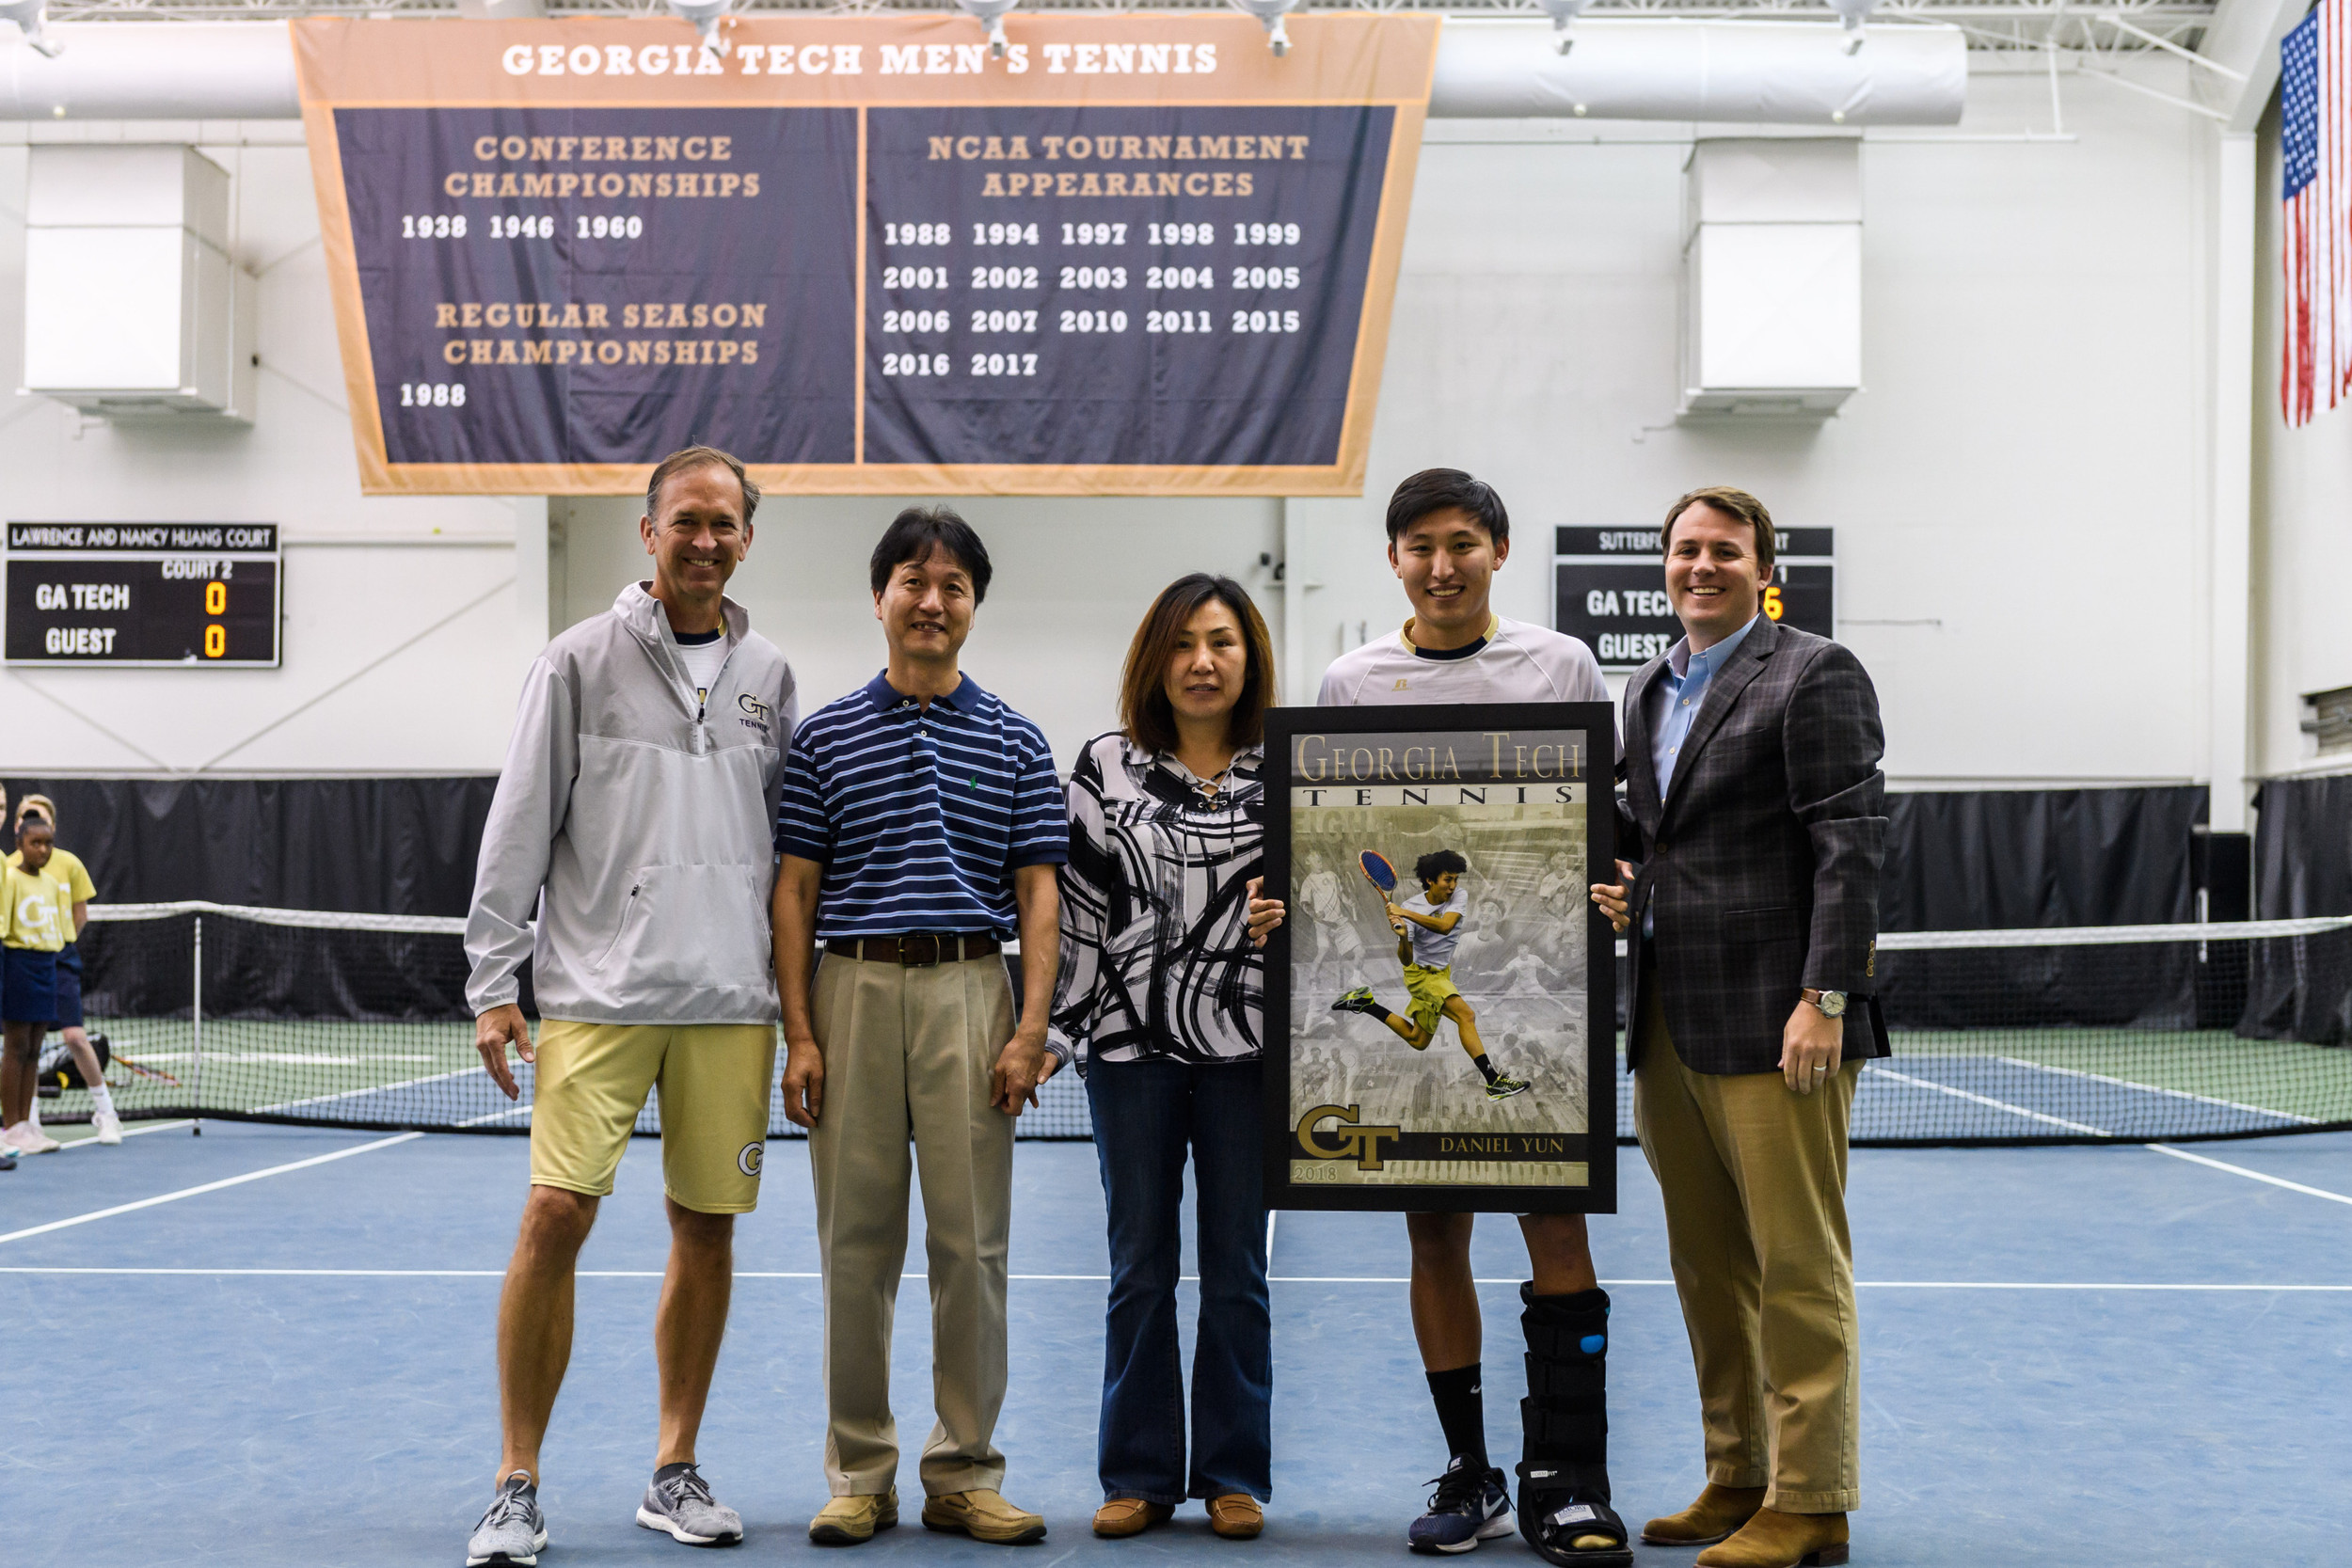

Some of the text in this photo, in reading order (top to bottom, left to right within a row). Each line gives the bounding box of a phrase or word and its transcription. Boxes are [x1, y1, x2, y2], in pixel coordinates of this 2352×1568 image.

[501, 43, 724, 76] GEORGIA
[736, 43, 864, 75] TECH
[1042, 43, 1218, 74] TENNIS
[473, 135, 733, 161] CONFERENCE
[928, 135, 1310, 161] NCAA TOURNAMENT
[443, 172, 761, 198] CHAMPIONSHIPS
[981, 172, 1254, 197] APPEARANCES
[401, 215, 643, 239] 1938 1946 1960
[884, 222, 1300, 246] 1988 1994 1997 1998 1999
[882, 266, 1300, 290] 2001 2002 2003 2004 2005
[435, 303, 768, 328] REGULAR SEASON
[882, 309, 1300, 333] 2006 2007 2010 2011 2015
[442, 340, 760, 365] CHAMPIONSHIPS
[882, 353, 1039, 376] 2016 2017
[399, 383, 467, 407] 1988
[11, 527, 272, 548] LAWRENCE AND NANCY HUANG COURT
[1599, 531, 1662, 551] SUTTERFI
[161, 561, 233, 579] COURT 2
[1778, 566, 1788, 584] 1
[35, 584, 131, 610] GA TECH
[205, 581, 227, 615] 0
[1586, 590, 1620, 617] GA
[1764, 586, 1784, 621] 6
[45, 627, 117, 655] GUEST
[204, 625, 226, 658] 0
[1597, 633, 1671, 659] GUEST
[1303, 785, 1572, 807] TENNIS
[1295, 1103, 1401, 1171] GT
[1439, 1137, 1565, 1153] DANIEL YUN
[1294, 1165, 1338, 1182] 2018
